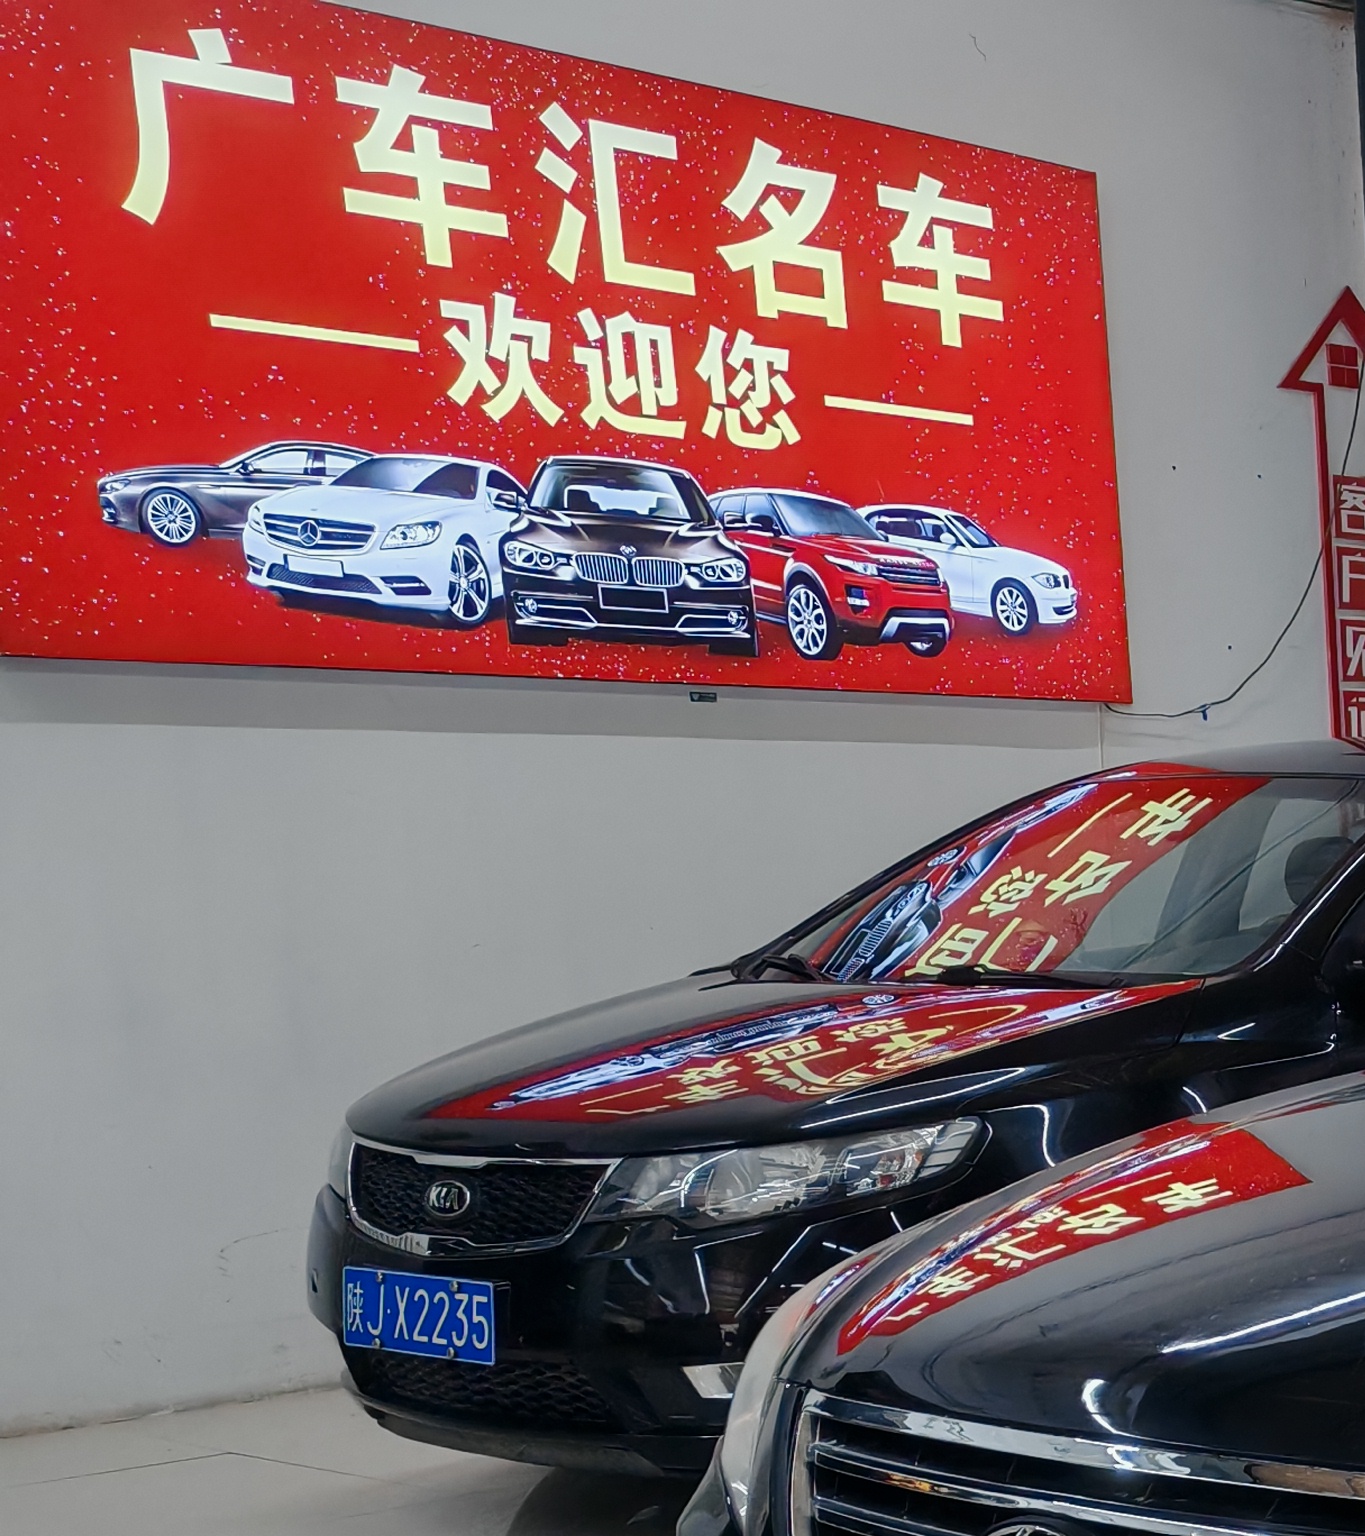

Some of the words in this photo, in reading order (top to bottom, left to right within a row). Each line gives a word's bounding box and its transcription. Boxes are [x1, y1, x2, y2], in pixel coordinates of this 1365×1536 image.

[122, 28, 1004, 348] 广车汇名车
[440, 292, 802, 451] 欢迎您
[429, 1186, 459, 1210] KIA
